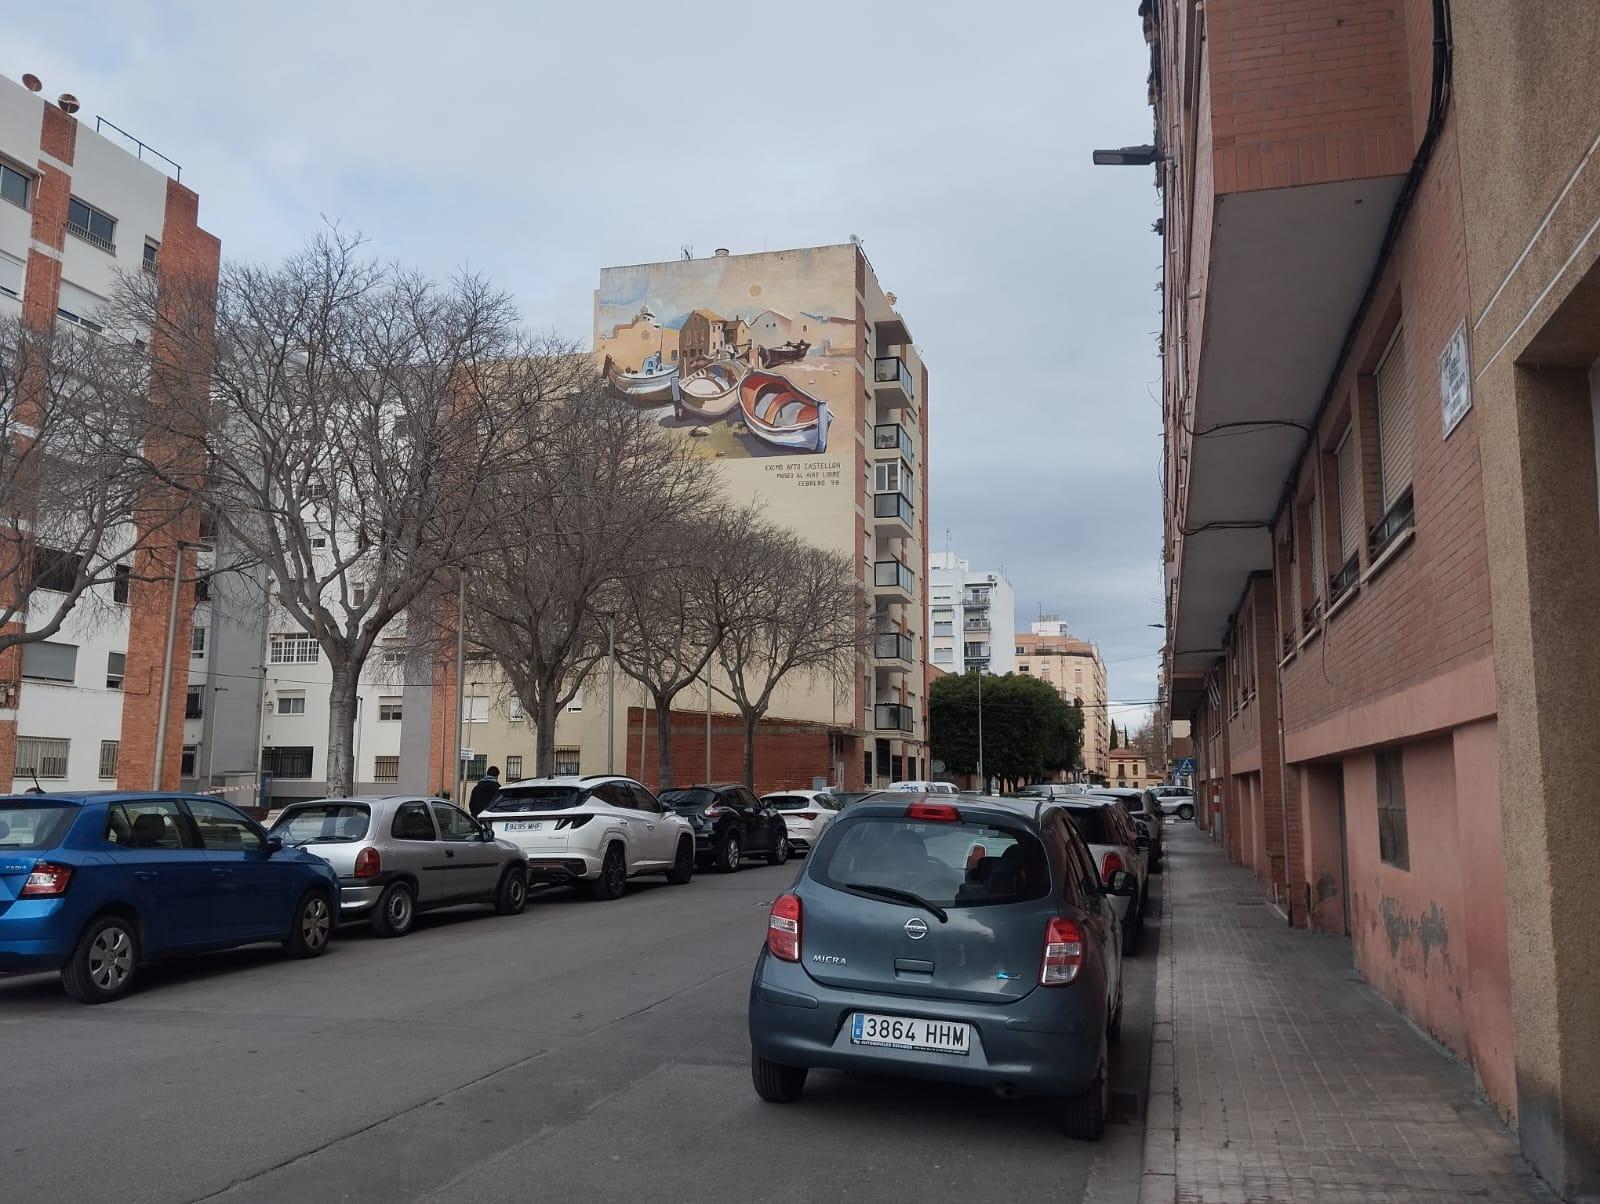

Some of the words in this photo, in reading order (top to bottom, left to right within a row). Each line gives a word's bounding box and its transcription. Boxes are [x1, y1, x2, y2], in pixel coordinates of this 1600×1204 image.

[804, 462, 840, 470] CASTELLON
[813, 955, 847, 966] MICRA
[866, 1018, 916, 1042] 3864
[925, 1023, 965, 1047] HHM
